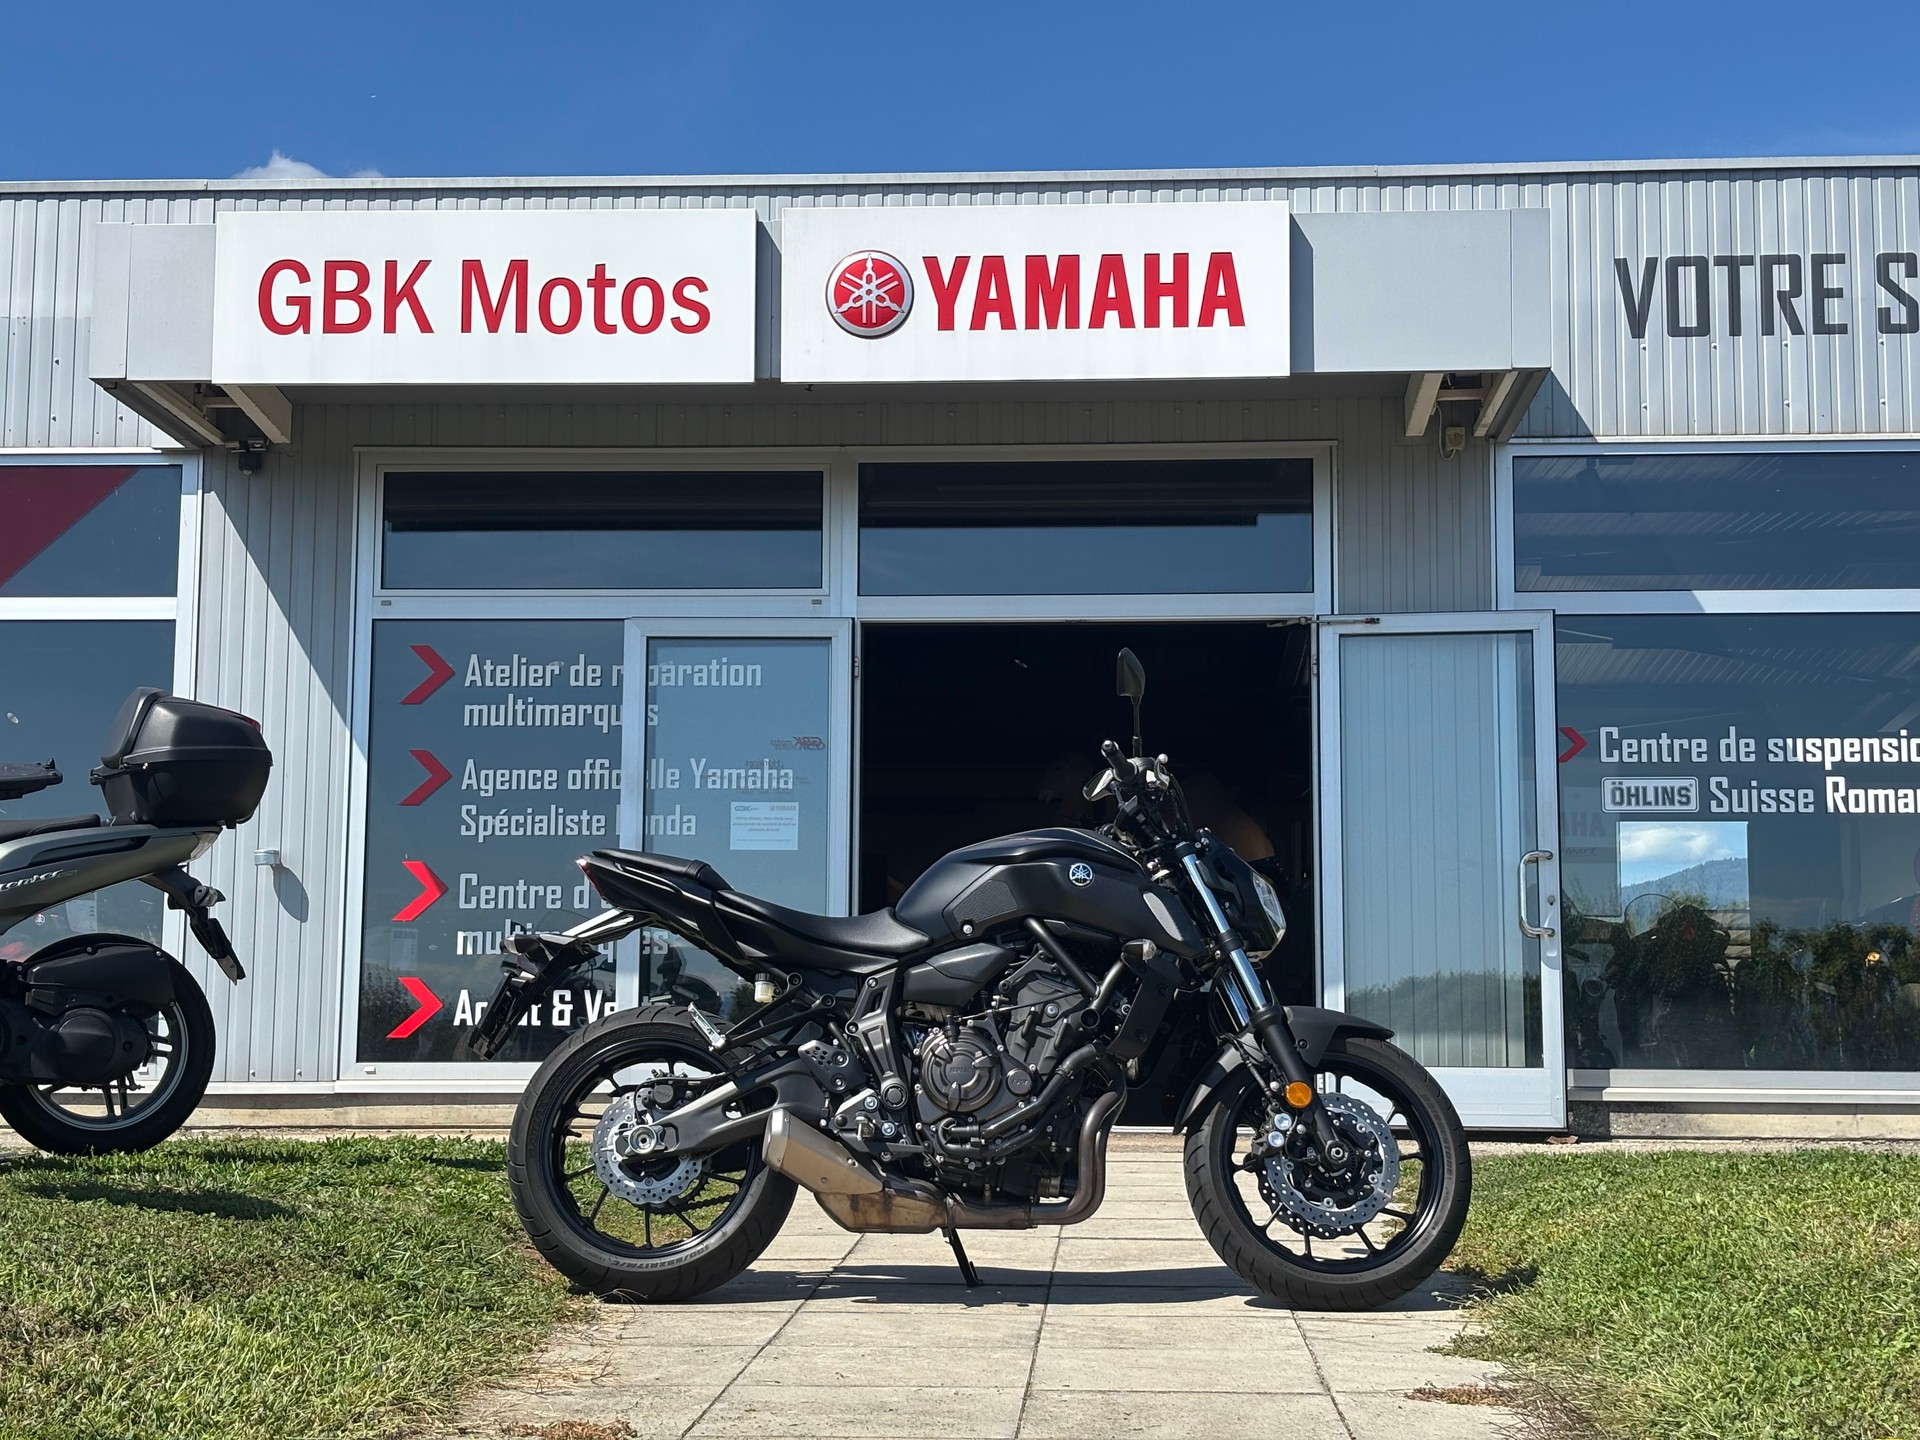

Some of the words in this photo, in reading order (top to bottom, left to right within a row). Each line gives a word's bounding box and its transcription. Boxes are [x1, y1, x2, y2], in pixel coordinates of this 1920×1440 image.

[258, 258, 434, 335] GBK
[460, 258, 711, 335] Motos
[922, 251, 1246, 331] YAMAHA
[1614, 253, 1849, 339] VOTRE
[1876, 252, 1920, 334] S
[464, 653, 561, 687] Atelier
[569, 653, 602, 687] de
[611, 657, 762, 687] rparation
[463, 694, 659, 734] multimarqus
[1600, 726, 1708, 763] Centre
[1719, 725, 1756, 763] de
[461, 758, 558, 795] Agence
[567, 758, 680, 790] officlle
[690, 757, 794, 790] Yamaha
[1609, 780, 1692, 807] ÖHLINS
[1709, 776, 1815, 814] Suisse
[1825, 776, 1920, 814] Roma
[460, 804, 606, 843] Spécialiste
[616, 804, 697, 836] nda
[458, 872, 562, 910] Centre
[552, 989, 574, 1027] &
